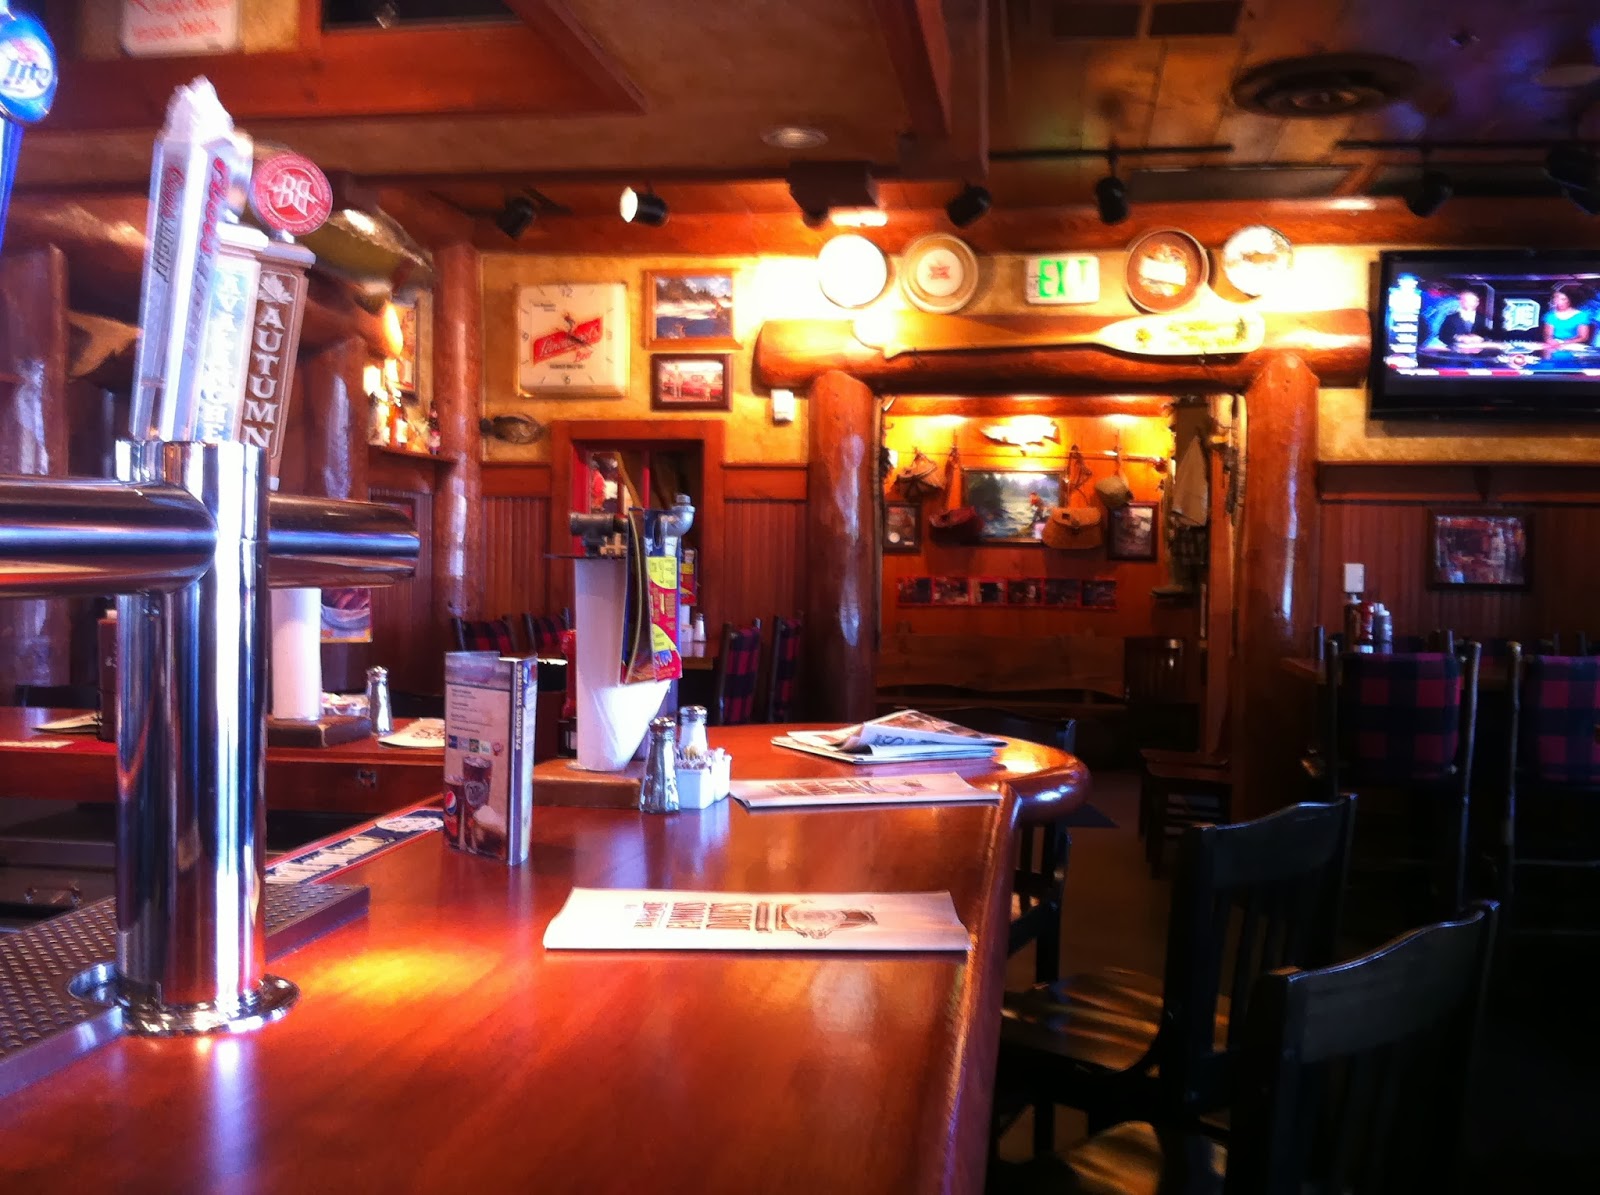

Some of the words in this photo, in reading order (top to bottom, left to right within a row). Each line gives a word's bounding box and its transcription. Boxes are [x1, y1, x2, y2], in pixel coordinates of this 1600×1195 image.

[160, 165, 186, 219] Coors
[201, 157, 230, 255] Coors
[152, 217, 178, 284] LIGHT
[1038, 258, 1090, 298] EXT
[242, 307, 285, 449] AUTUMN
